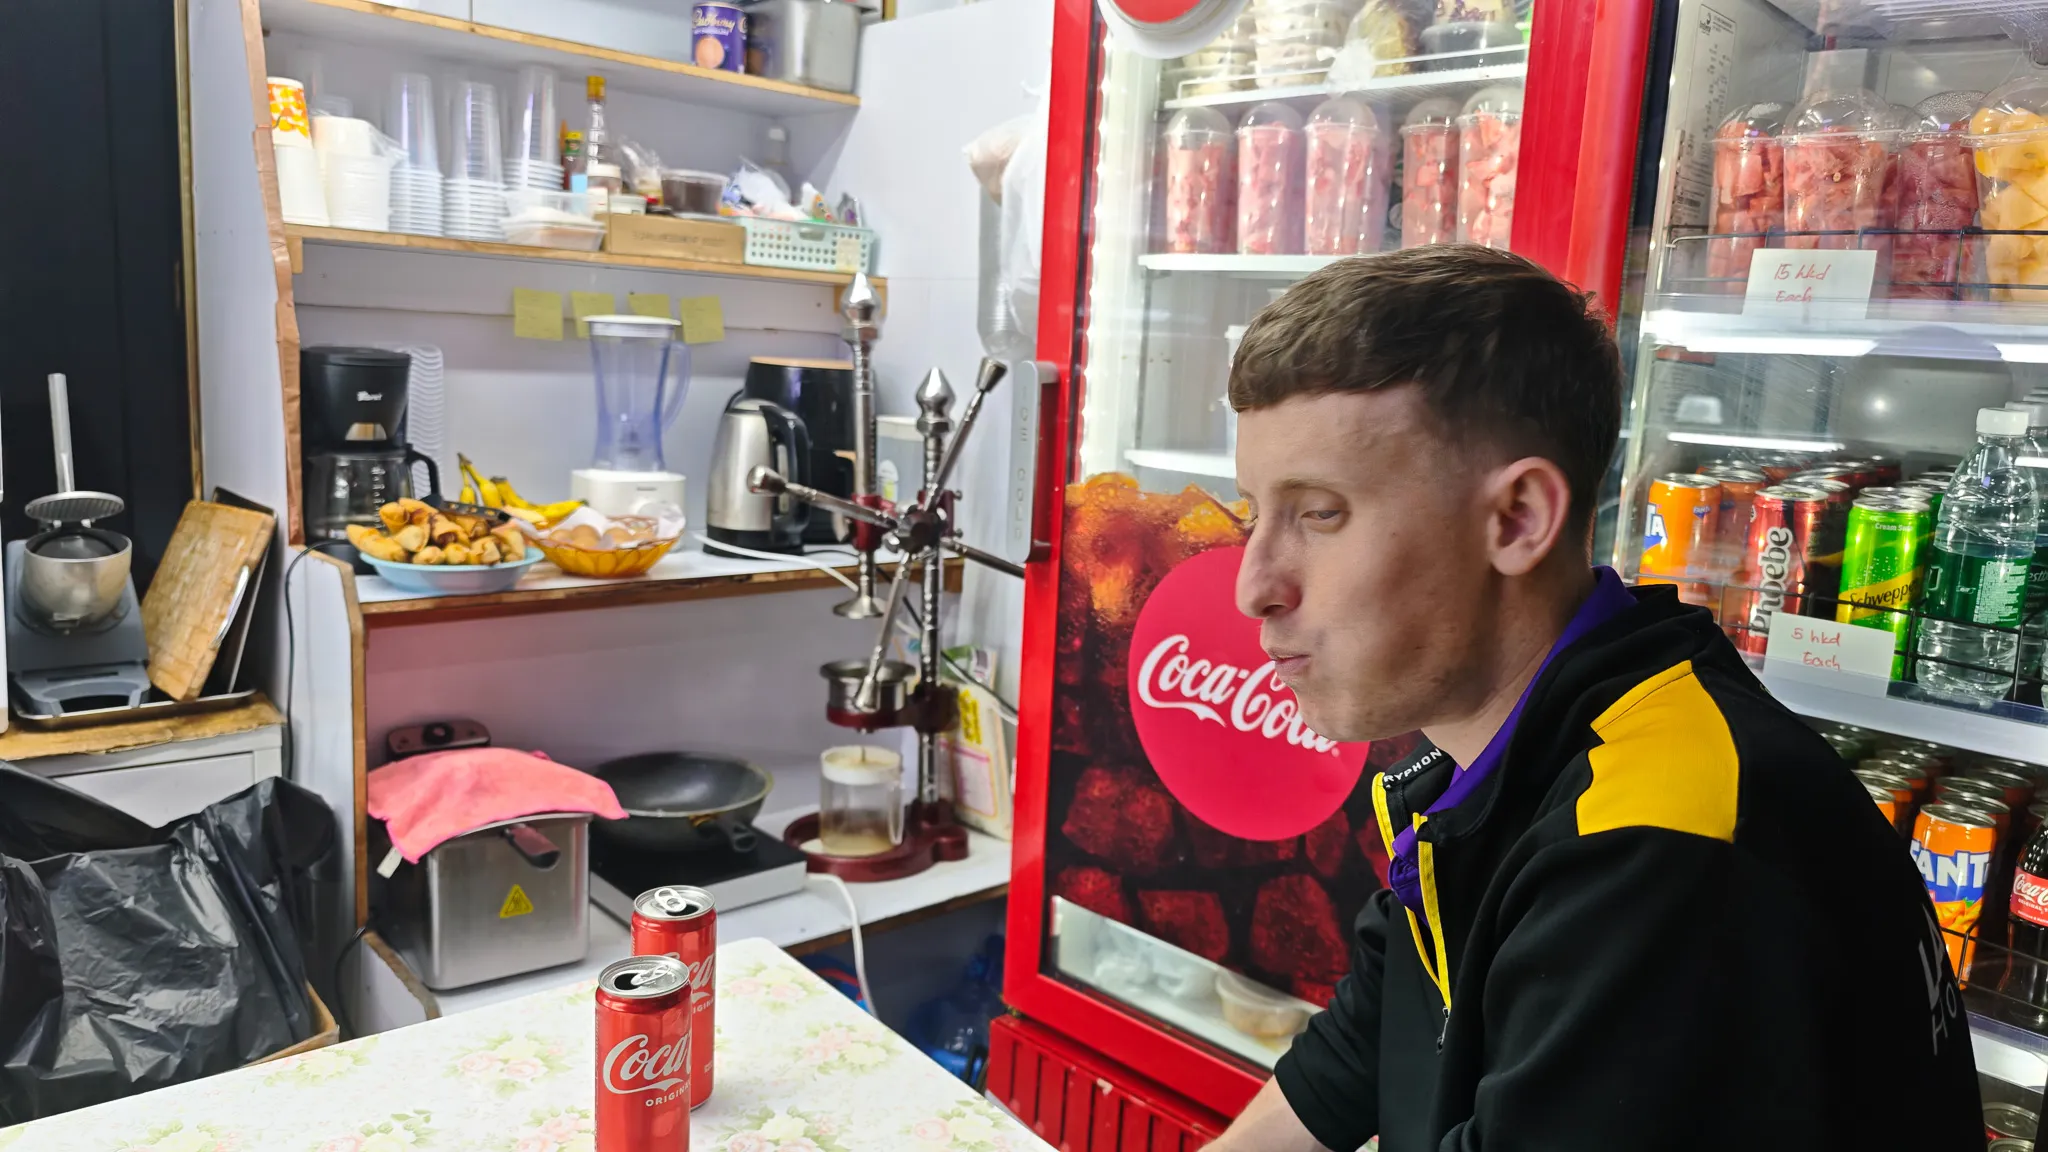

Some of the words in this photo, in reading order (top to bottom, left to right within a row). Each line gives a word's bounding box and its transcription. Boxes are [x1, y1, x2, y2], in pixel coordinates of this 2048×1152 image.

[1774, 263, 1792, 280] 15
[1795, 263, 1831, 281] hkd
[1775, 286, 1813, 303] Each
[1791, 627, 1804, 640] 5
[1809, 629, 1841, 646] hkd
[1803, 651, 1841, 671] Each
[1383, 748, 1443, 783] RYPHON
[1910, 840, 1989, 888] FANT
[2013, 874, 2048, 906] Coca-C
[1931, 981, 1958, 1057] HO
[603, 1033, 692, 1095] Coca
[645, 1080, 692, 1107] ORIGINA
